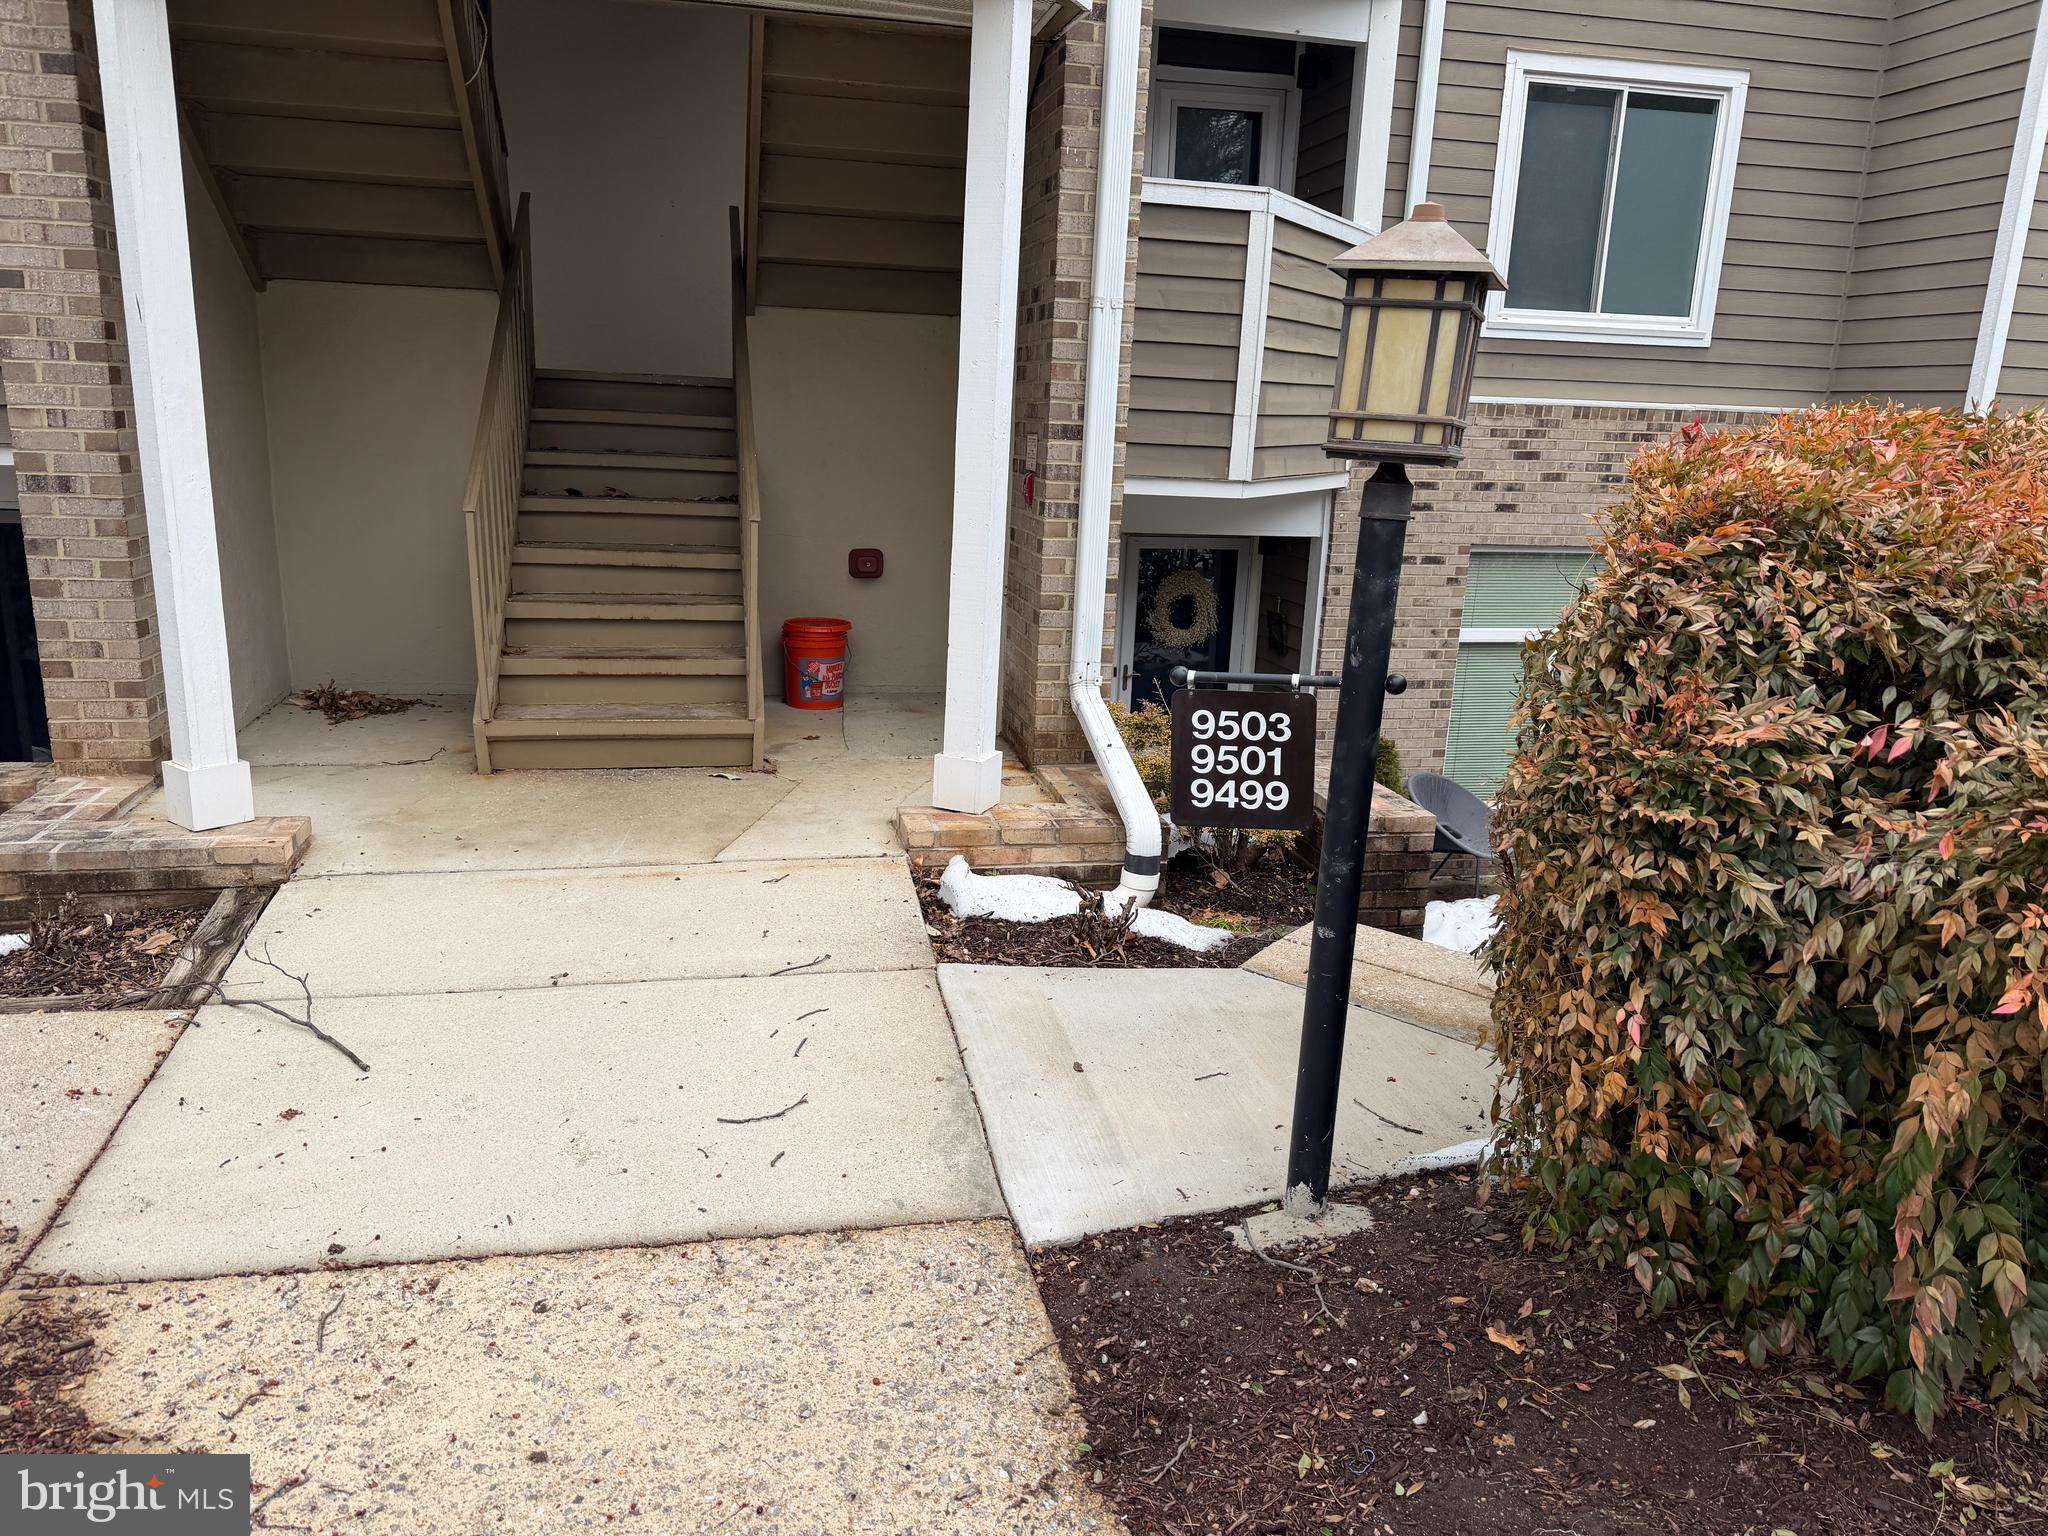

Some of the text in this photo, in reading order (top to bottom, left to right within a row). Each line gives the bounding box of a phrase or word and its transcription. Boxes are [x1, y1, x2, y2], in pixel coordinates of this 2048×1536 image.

[1191, 709, 1292, 742] 9503
[1190, 744, 1282, 776] 9501
[1190, 778, 1290, 811] 9499
